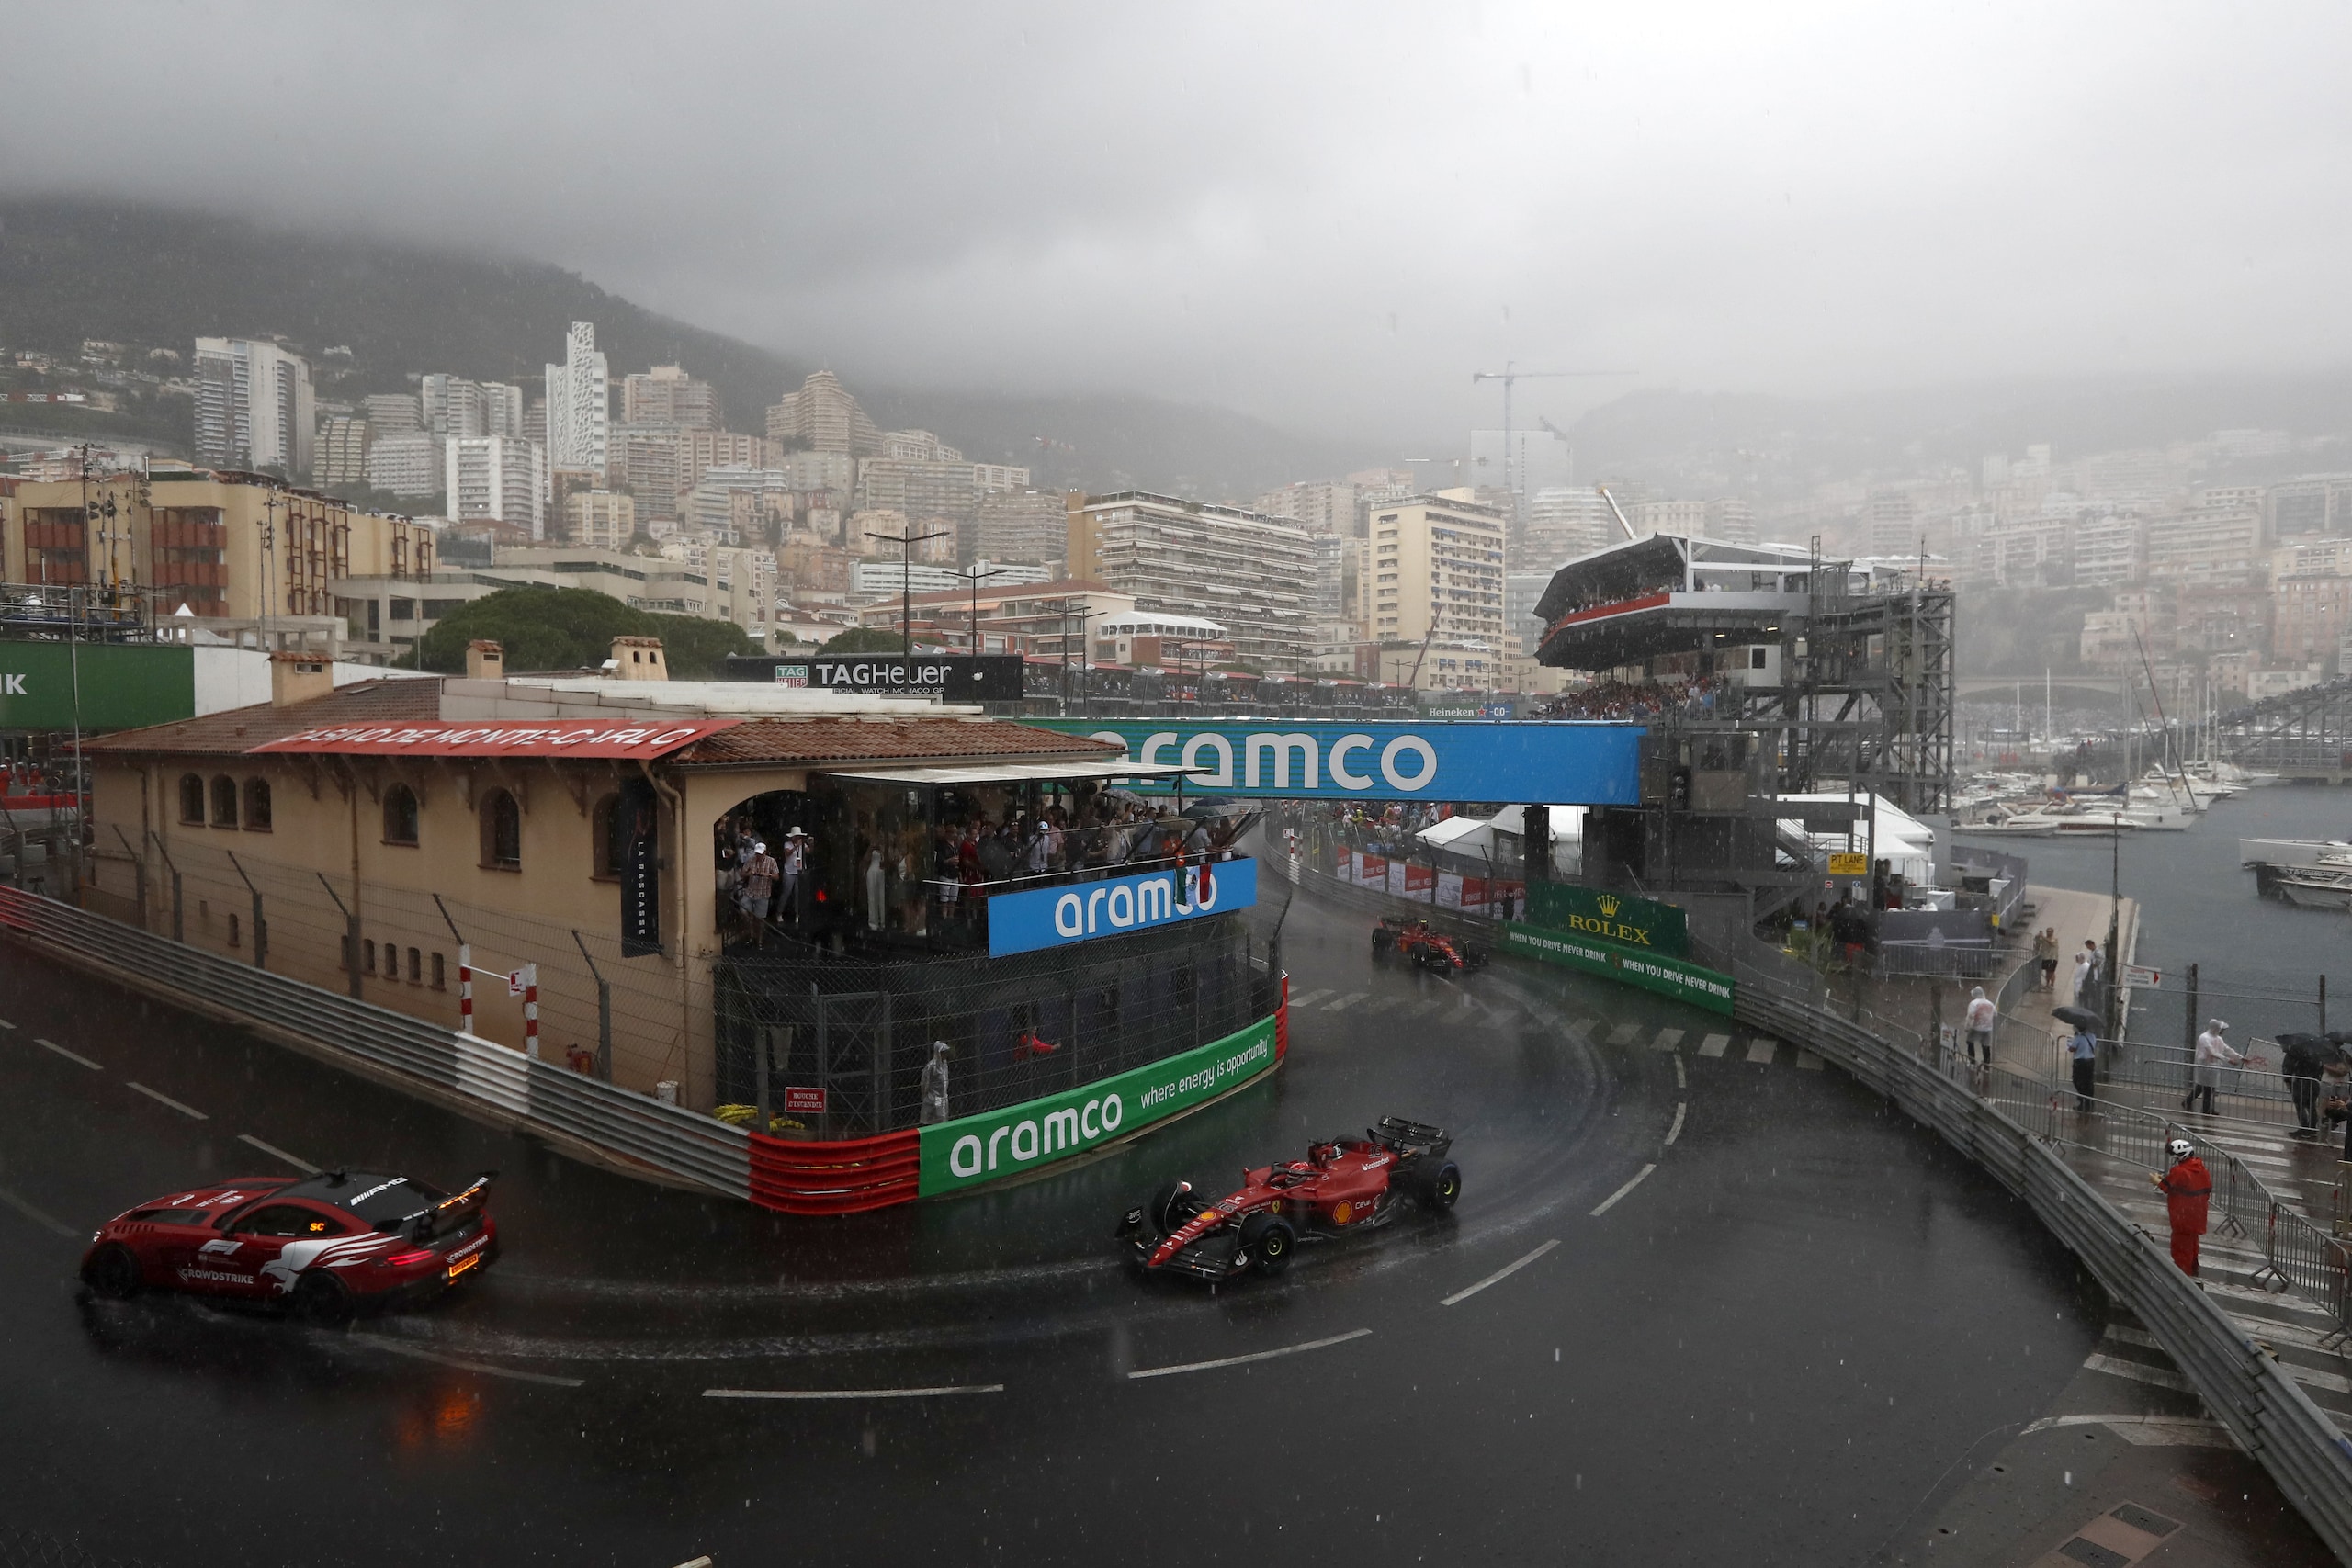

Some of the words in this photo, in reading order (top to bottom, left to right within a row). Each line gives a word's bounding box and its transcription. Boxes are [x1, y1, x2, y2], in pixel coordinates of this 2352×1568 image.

[778, 667, 805, 676] TAG
[0, 673, 28, 695] K
[1429, 706, 1475, 716] Heineken
[279, 728, 391, 742] CASINO
[420, 728, 696, 745] MONTE-CARLO
[637, 841, 645, 857] LA
[1831, 854, 1842, 864] PIT
[1844, 854, 1864, 864] LANE
[638, 863, 646, 936] RASCASSE
[1054, 873, 1217, 938] aramo
[1567, 913, 1652, 947] ROLEX
[1509, 931, 1528, 944] WHEN
[1528, 935, 1542, 947] YOU
[1543, 939, 1562, 953] DRIVE
[1562, 942, 1584, 957] NEVER
[1584, 948, 1607, 963] DRINK
[1623, 958, 1645, 974] WHEN
[1645, 965, 1662, 978] YOU
[1663, 969, 1684, 984] DRIVE
[1684, 975, 1708, 992] NEVER
[1708, 981, 1731, 999] DRINK
[1140, 1082, 1176, 1110] where
[1178, 1066, 1215, 1089] energy
[1216, 1059, 1225, 1077] is
[1226, 1038, 1269, 1076] opportunity
[793, 1092, 819, 1100] BOUCHE
[949, 1093, 1123, 1178] aramco
[1368, 1144, 1384, 1159] 16
[368, 1176, 409, 1197] AMG
[309, 1222, 325, 1232] SC
[181, 1268, 254, 1285] CROWDSTRIKE
